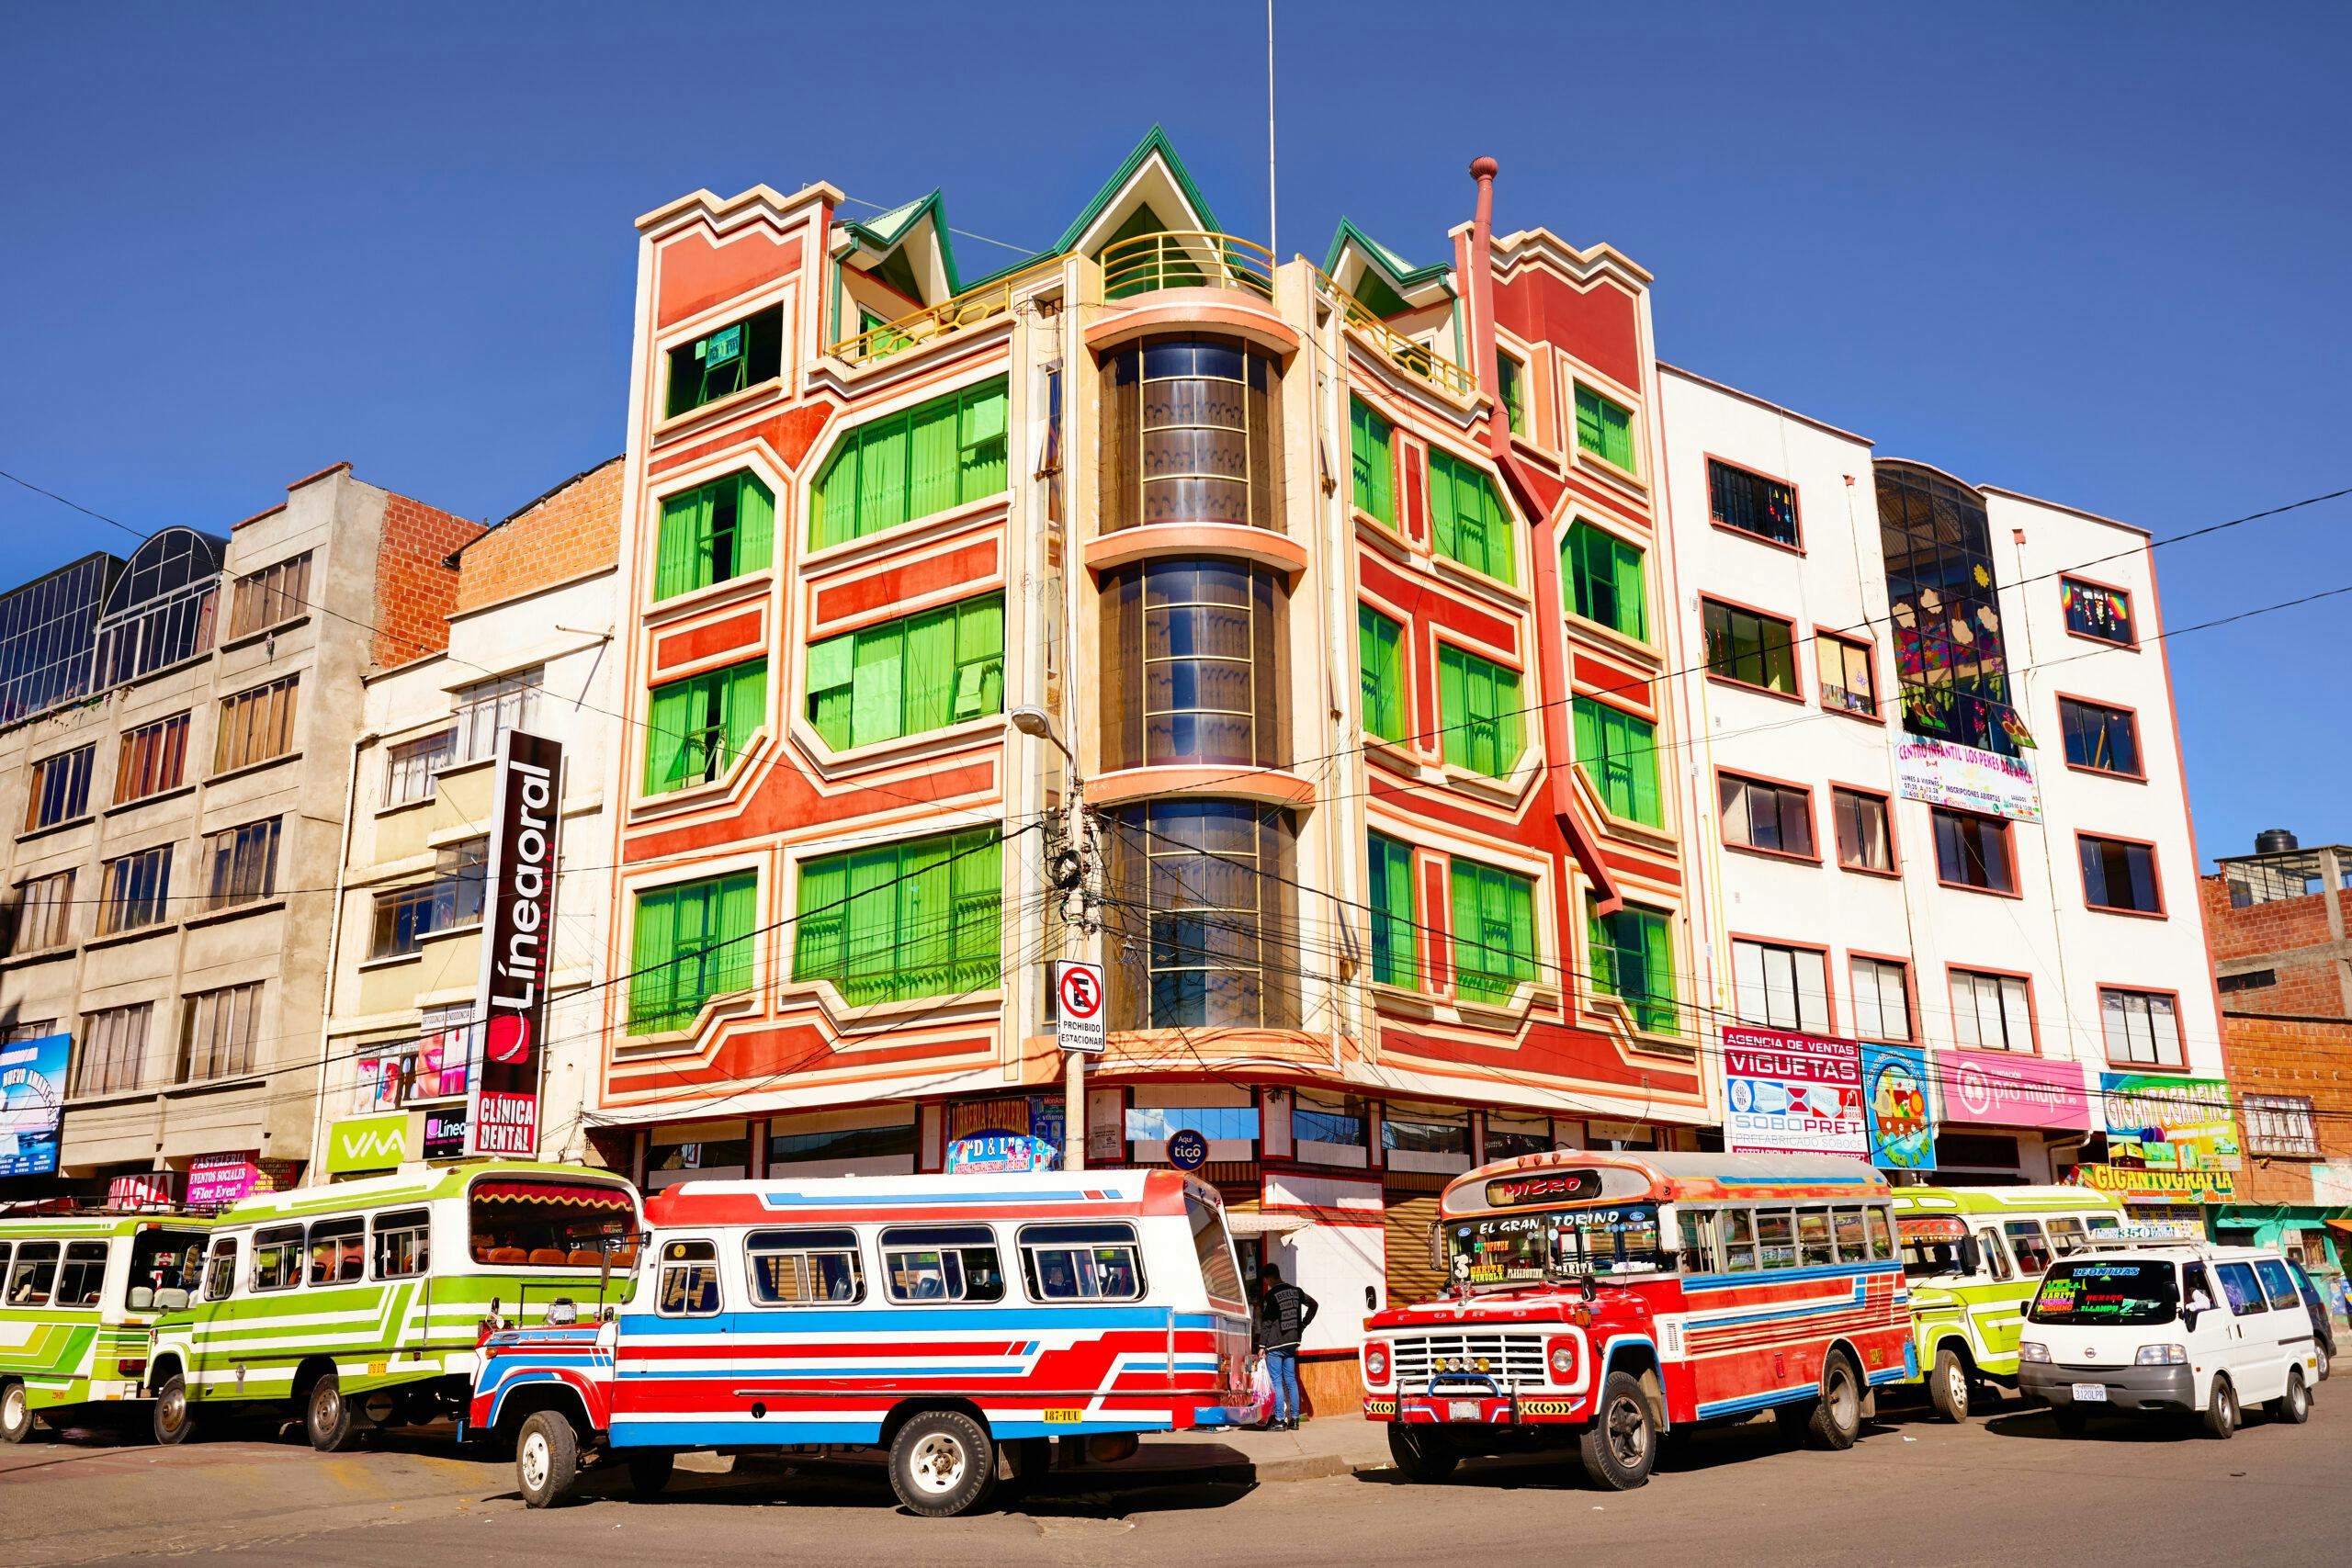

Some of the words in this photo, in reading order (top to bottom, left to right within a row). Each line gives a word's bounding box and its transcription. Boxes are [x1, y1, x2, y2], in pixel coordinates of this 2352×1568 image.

[1899, 744, 1926, 761] CENTRO
[1928, 744, 1962, 761] INFANTIL
[1978, 751, 2000, 772] PEKES
[2001, 758, 2015, 776] DEL
[1921, 777, 1939, 787] VIERNES
[1945, 784, 1980, 798] INSCRIPCIONES
[1980, 790, 2000, 803] ABIERTAS
[492, 761, 550, 1010] Líneaoral
[535, 842, 553, 991] ESPECIALISTAS
[1061, 1033, 1102, 1046] ESTACIONAR
[1727, 1033, 1782, 1047] AGENCIA
[1787, 1039, 1804, 1051] DE
[1807, 1042, 1854, 1055] VENTAS
[3, 1067, 27, 1088] NUEVO
[1730, 1053, 1856, 1080] VIGUETAS
[1993, 1080, 2020, 1109] pro
[2025, 1080, 2066, 1113] mujer
[2106, 1083, 2232, 1130] GIGANTOGRAFIAS
[481, 1094, 534, 1125] CLÍNICA
[988, 1101, 1029, 1137] PAPELERIA
[1735, 1115, 1860, 1134] SOBOPRET
[480, 1124, 529, 1152] DENTAL
[988, 1137, 996, 1156] &
[1736, 1134, 1818, 1147] PREFABRICADO
[1822, 1137, 1863, 1149] SOBOCE
[192, 1153, 246, 1170] PASTELERIA
[189, 1171, 216, 1186] EVENTOS
[217, 1168, 246, 1181] SOCIALES
[1504, 1178, 1581, 1198] MICRO
[109, 1175, 170, 1209] MACIA
[1480, 1223, 1495, 1235] EL
[1499, 1218, 1540, 1232] GRAN
[1553, 1211, 1619, 1226] TORINO
[2118, 1228, 2152, 1238] 350
[1453, 1255, 1470, 1279] 3
[2073, 1267, 2140, 1277] LEONIDAS
